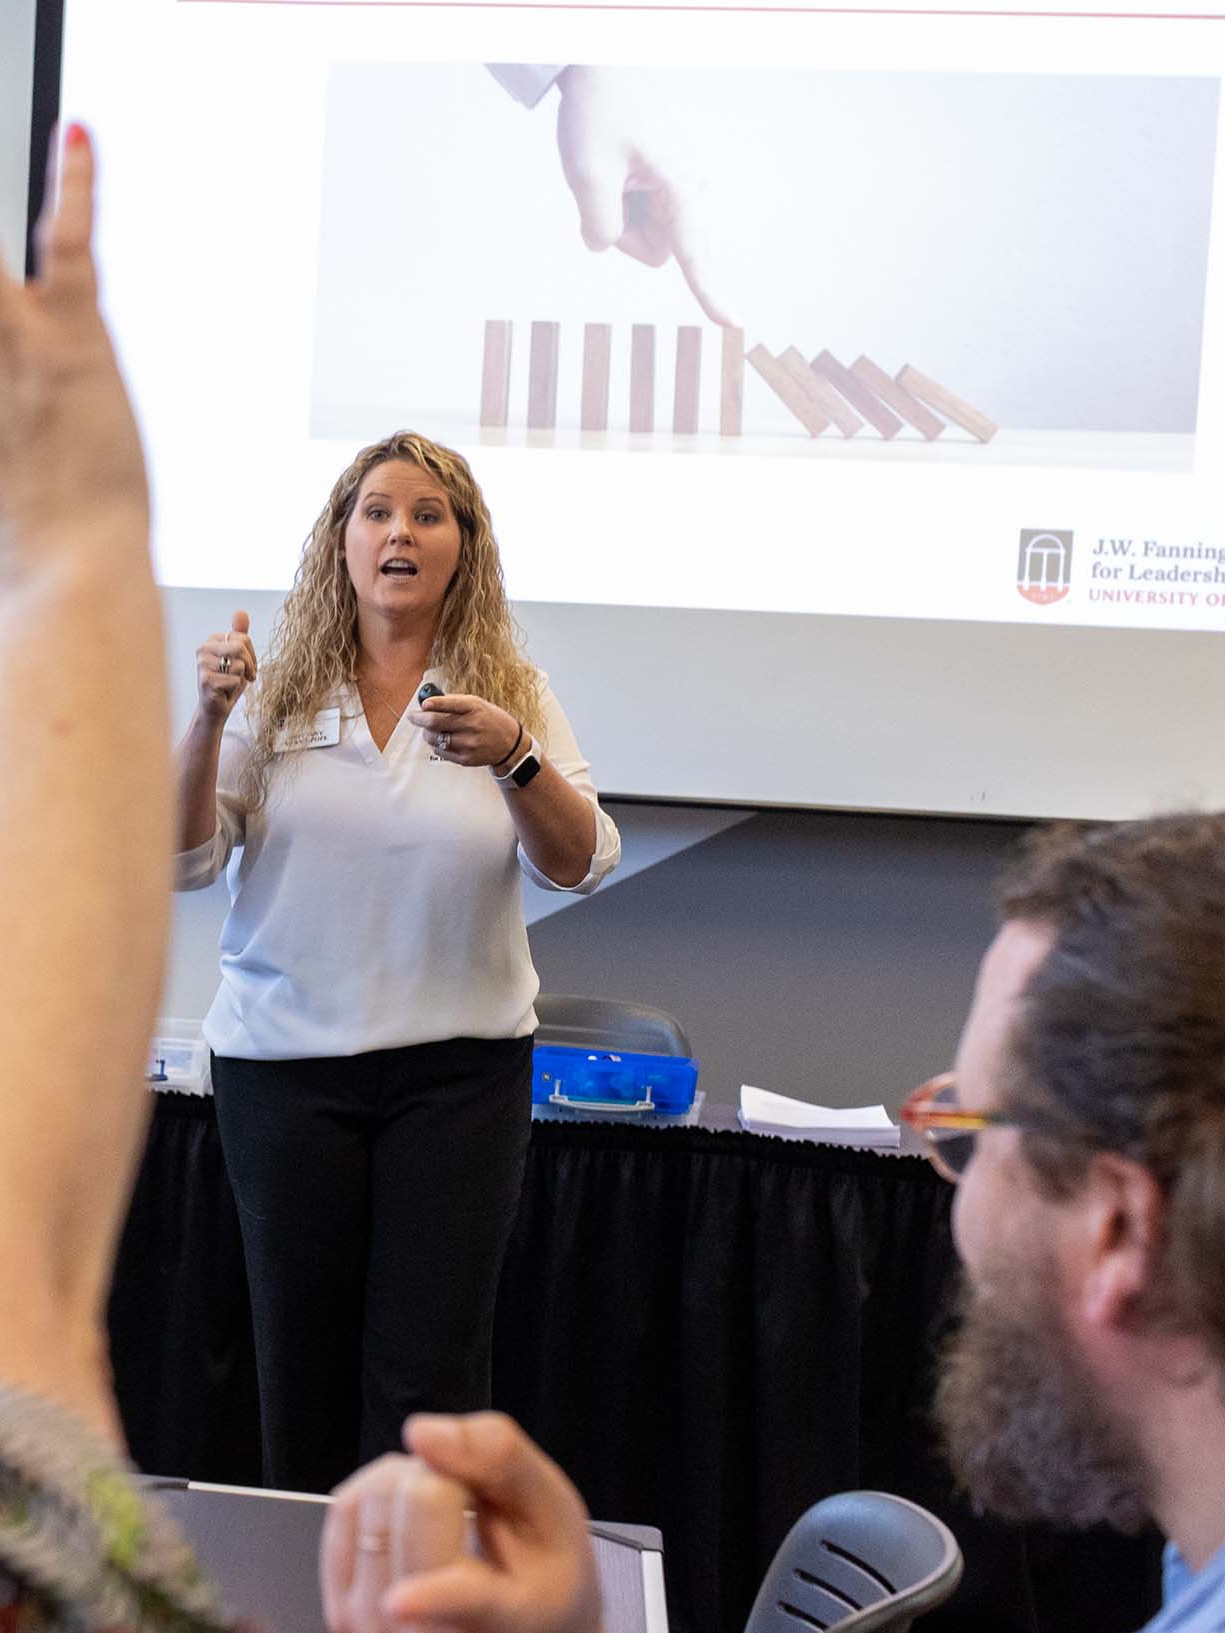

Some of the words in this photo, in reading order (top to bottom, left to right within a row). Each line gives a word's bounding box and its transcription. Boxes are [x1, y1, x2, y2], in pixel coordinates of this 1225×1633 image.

[1092, 539, 1136, 557] J.W.
[1143, 541, 1225, 564] Fanning
[1091, 561, 1123, 579] for
[1128, 564, 1225, 583] Leadersh
[1089, 588, 1199, 606] UNIVERSITY
